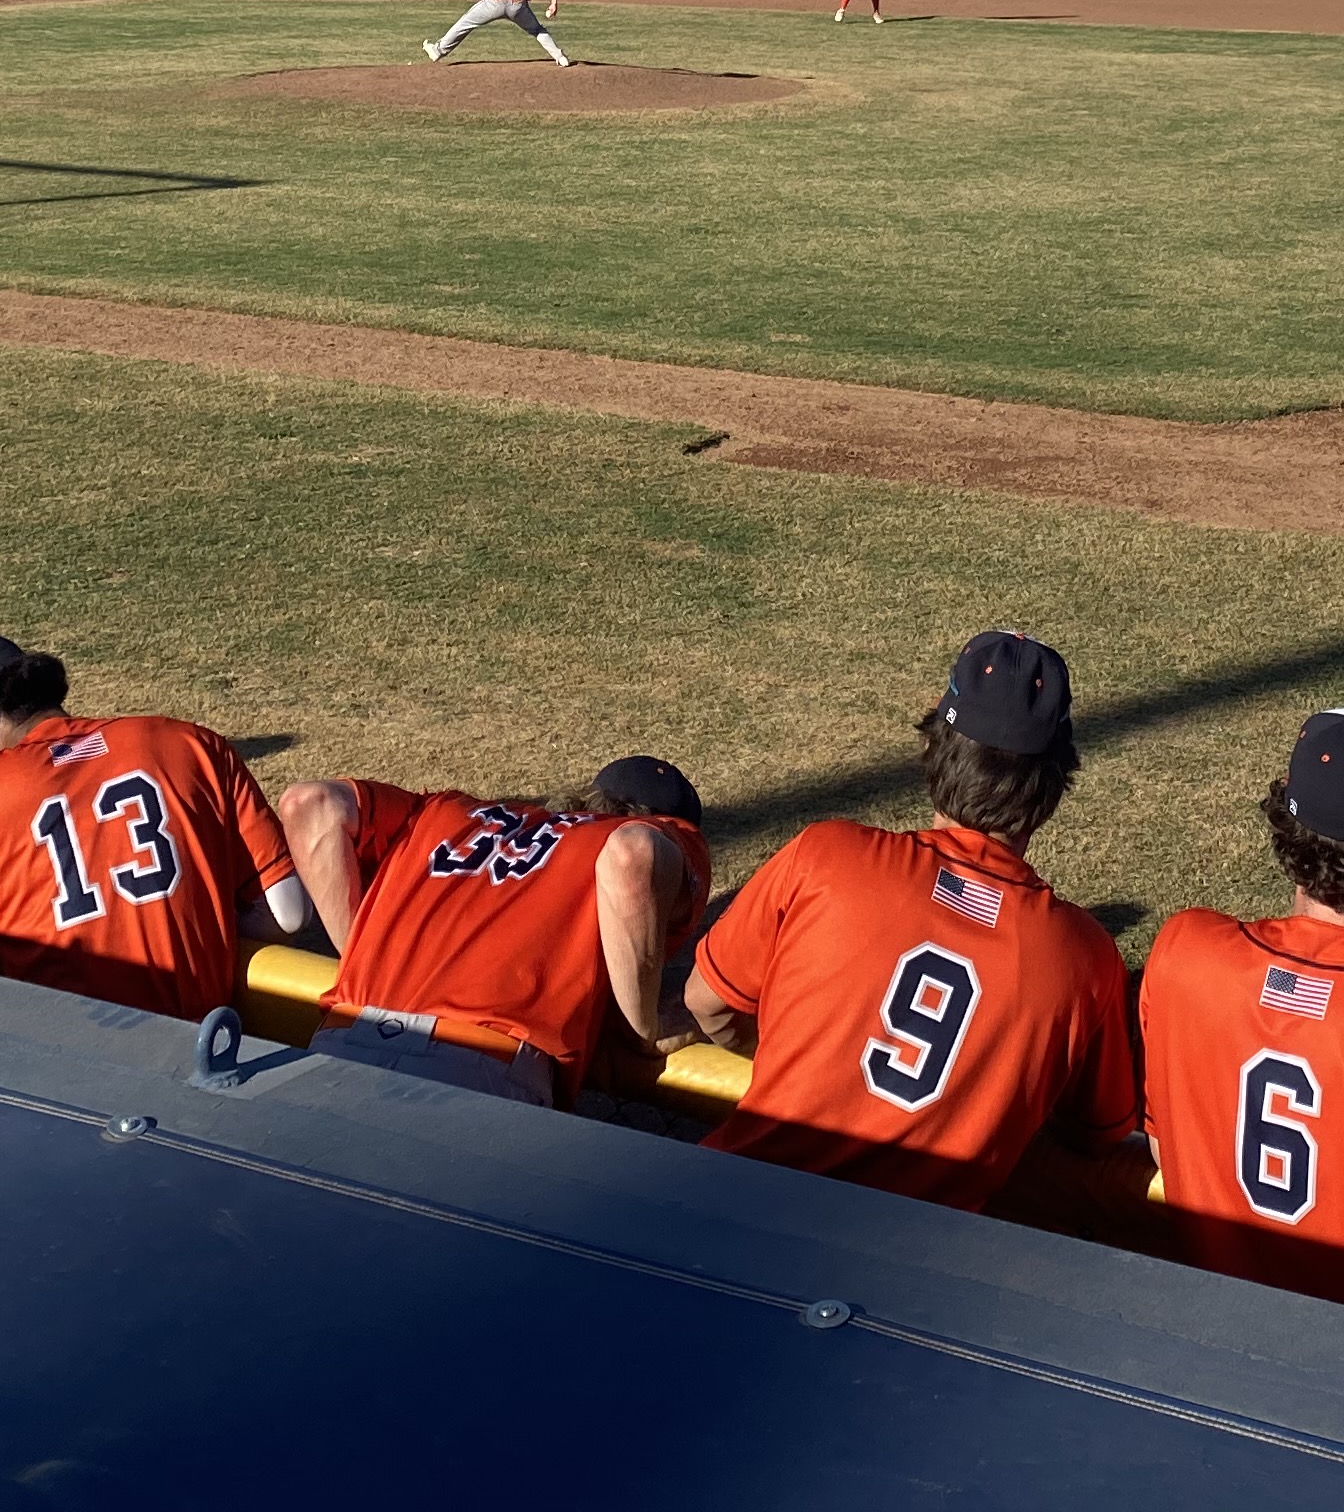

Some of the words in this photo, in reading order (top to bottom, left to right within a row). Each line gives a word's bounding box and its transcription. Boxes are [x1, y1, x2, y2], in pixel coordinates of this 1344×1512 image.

[30, 769, 183, 931] 13
[859, 940, 983, 1114] 9
[1235, 1046, 1323, 1227] 6
